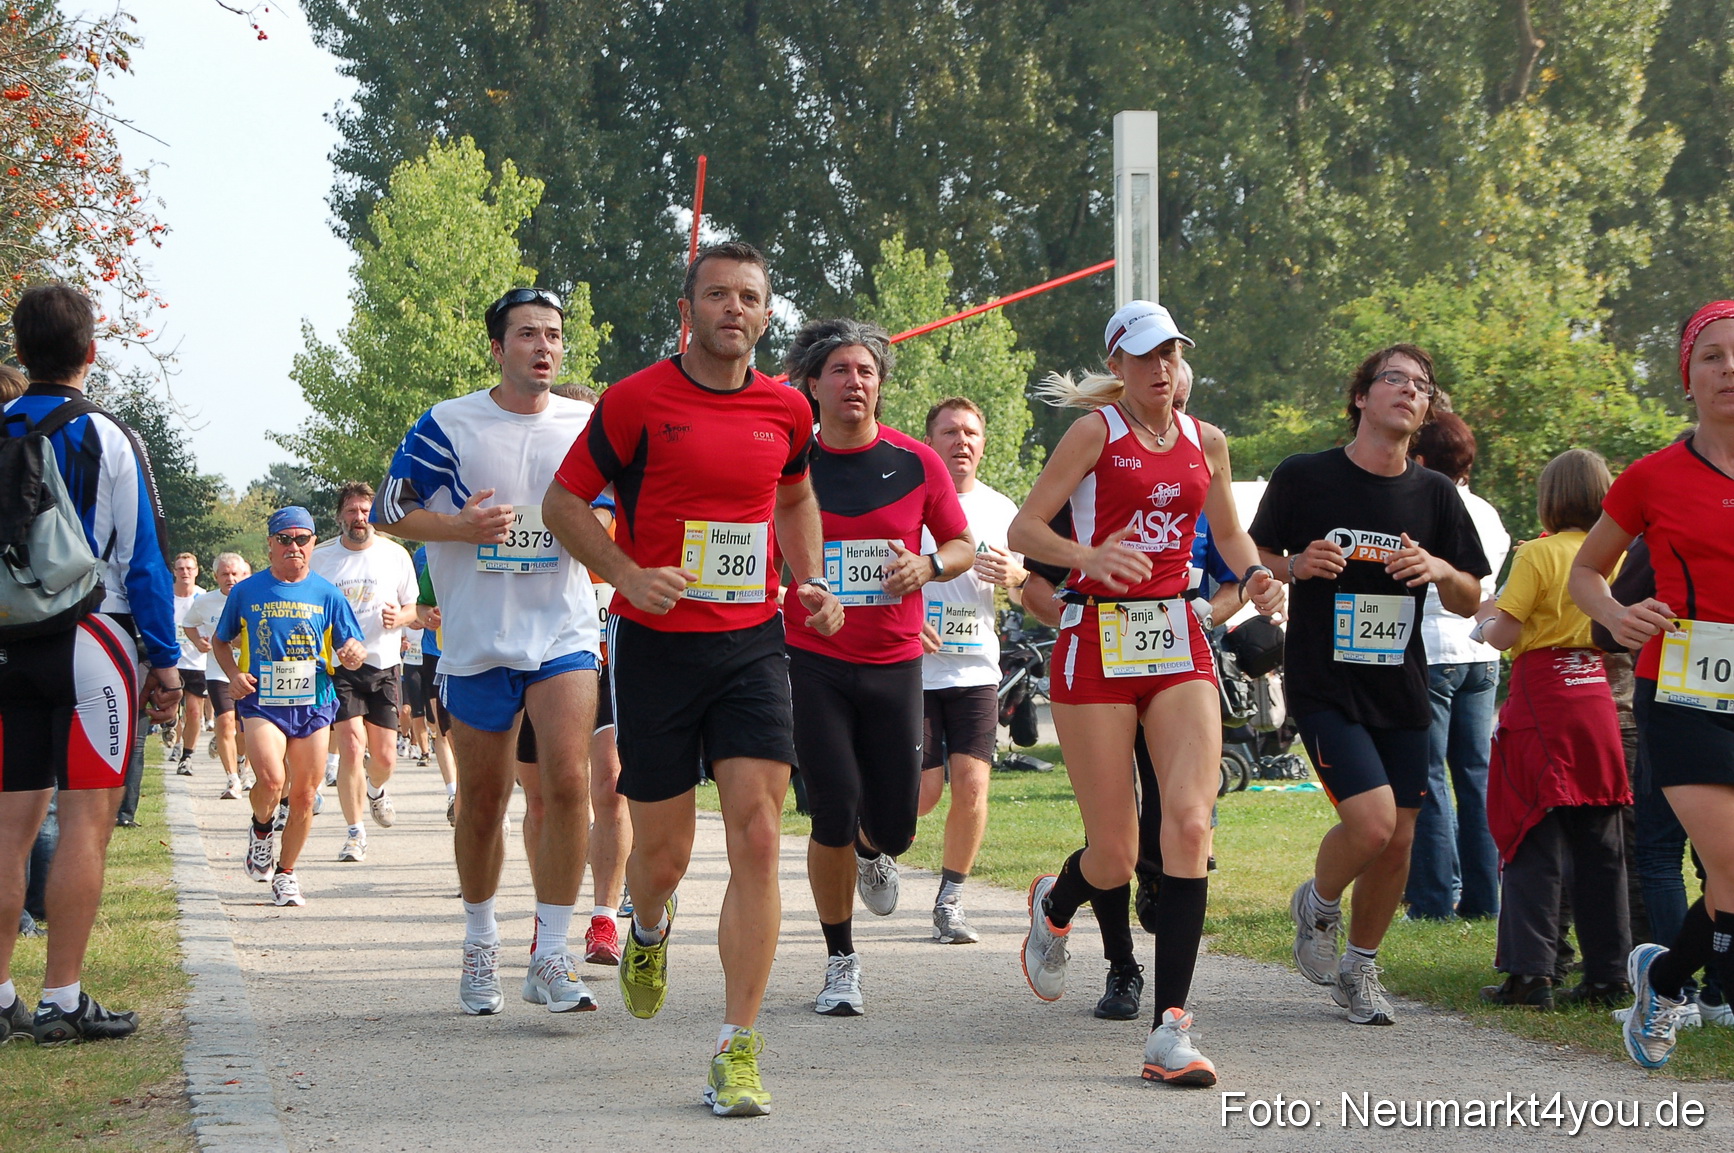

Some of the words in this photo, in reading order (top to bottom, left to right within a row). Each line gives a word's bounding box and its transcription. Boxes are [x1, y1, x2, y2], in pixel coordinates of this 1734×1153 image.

[753, 431, 774, 439] GORE
[1112, 455, 1142, 470] Tanja
[1122, 510, 1188, 543] ASK
[711, 529, 751, 545] Helmut
[846, 546, 890, 558] Herakles
[1136, 543, 1158, 551] Service
[1359, 547, 1393, 560] PAR
[686, 551, 693, 562] C
[717, 554, 756, 576] 380
[829, 566, 835, 575] C
[251, 604, 262, 613] 10.
[263, 601, 324, 615] NEUMARKTER
[946, 606, 977, 617] Manfred
[1360, 601, 1379, 613] Jan
[261, 609, 313, 619] STADTLAUF
[945, 621, 979, 636] 2441
[1339, 618, 1345, 628] B
[1359, 621, 1407, 640] 2447
[1104, 631, 1111, 642] C
[1134, 629, 1175, 651] 379
[275, 665, 296, 674] Horst
[1696, 656, 1734, 683] 10
[276, 678, 310, 690] 2172
